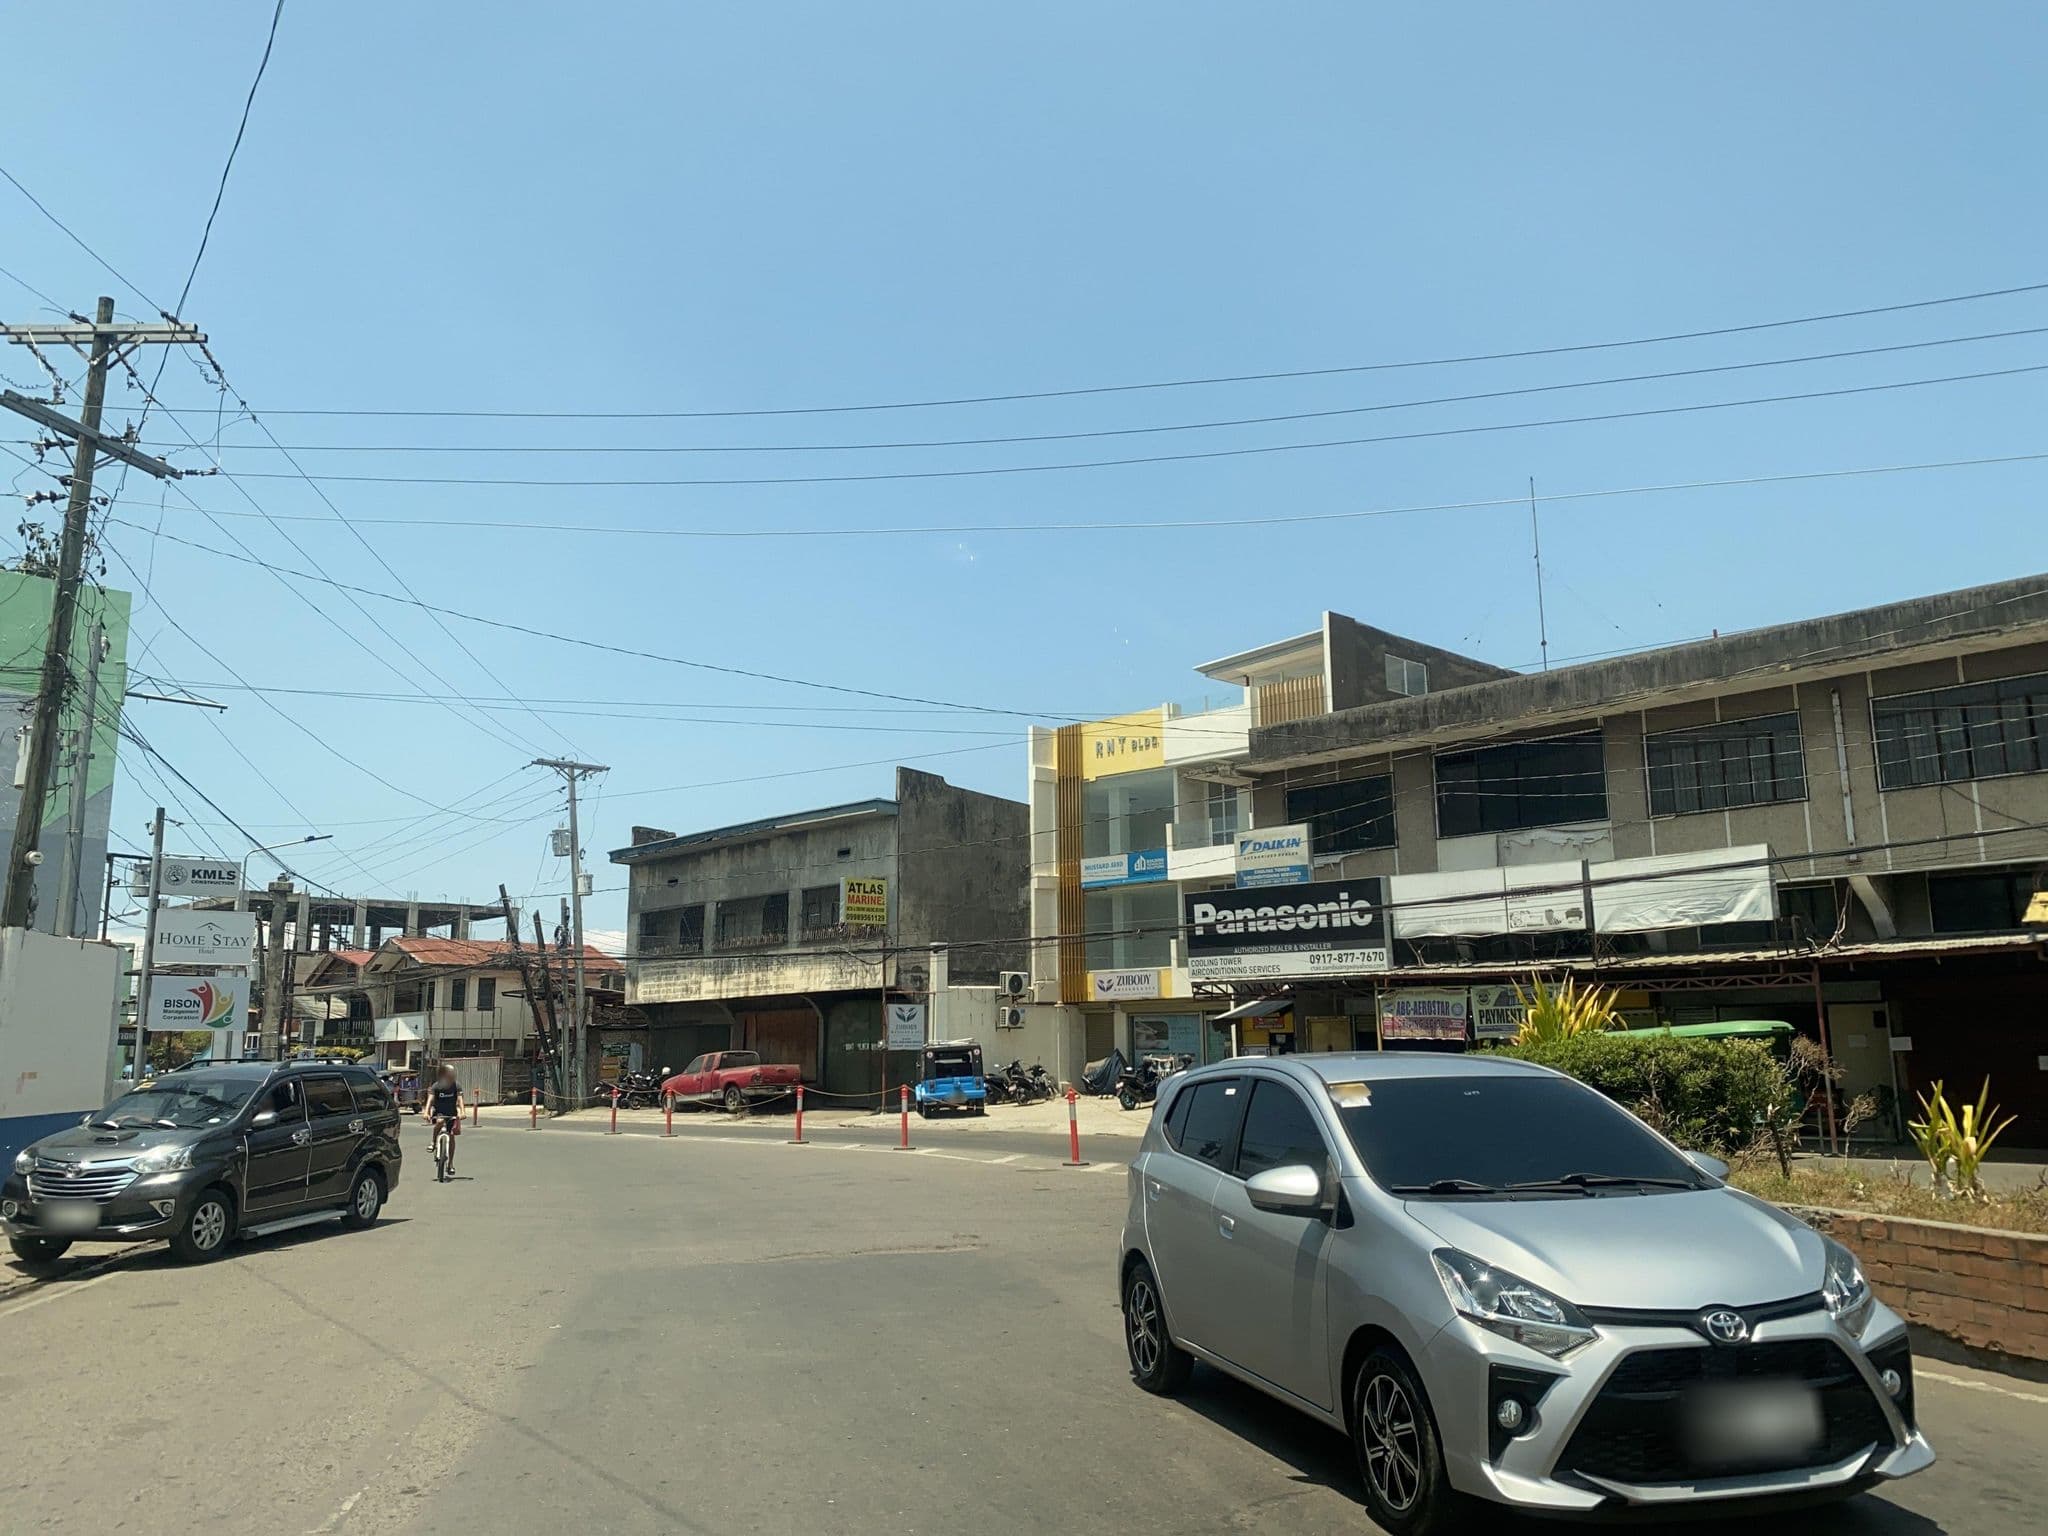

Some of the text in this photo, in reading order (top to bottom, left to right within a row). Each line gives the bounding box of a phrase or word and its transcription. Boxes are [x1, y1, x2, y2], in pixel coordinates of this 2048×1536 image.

[1253, 837, 1301, 851] DAIKIN
[191, 869, 237, 880] KMLS
[848, 882, 884, 895] ATLAS
[847, 894, 882, 905] MARINE
[1193, 892, 1373, 935] Panasonic
[159, 932, 250, 947] HOME STAY
[1270, 944, 1293, 952] DEALER
[1190, 952, 1385, 967] COOLING TOWER 0917-877-7670
[1191, 966, 1248, 976] AIRCONDITIONING
[1248, 964, 1281, 974] SERVICES
[1116, 973, 1152, 986] ZUBODY
[164, 999, 201, 1008] BISON
[1396, 1000, 1450, 1016] ABC-AEROSTAR
[1478, 1007, 1523, 1025] PAYMENT
